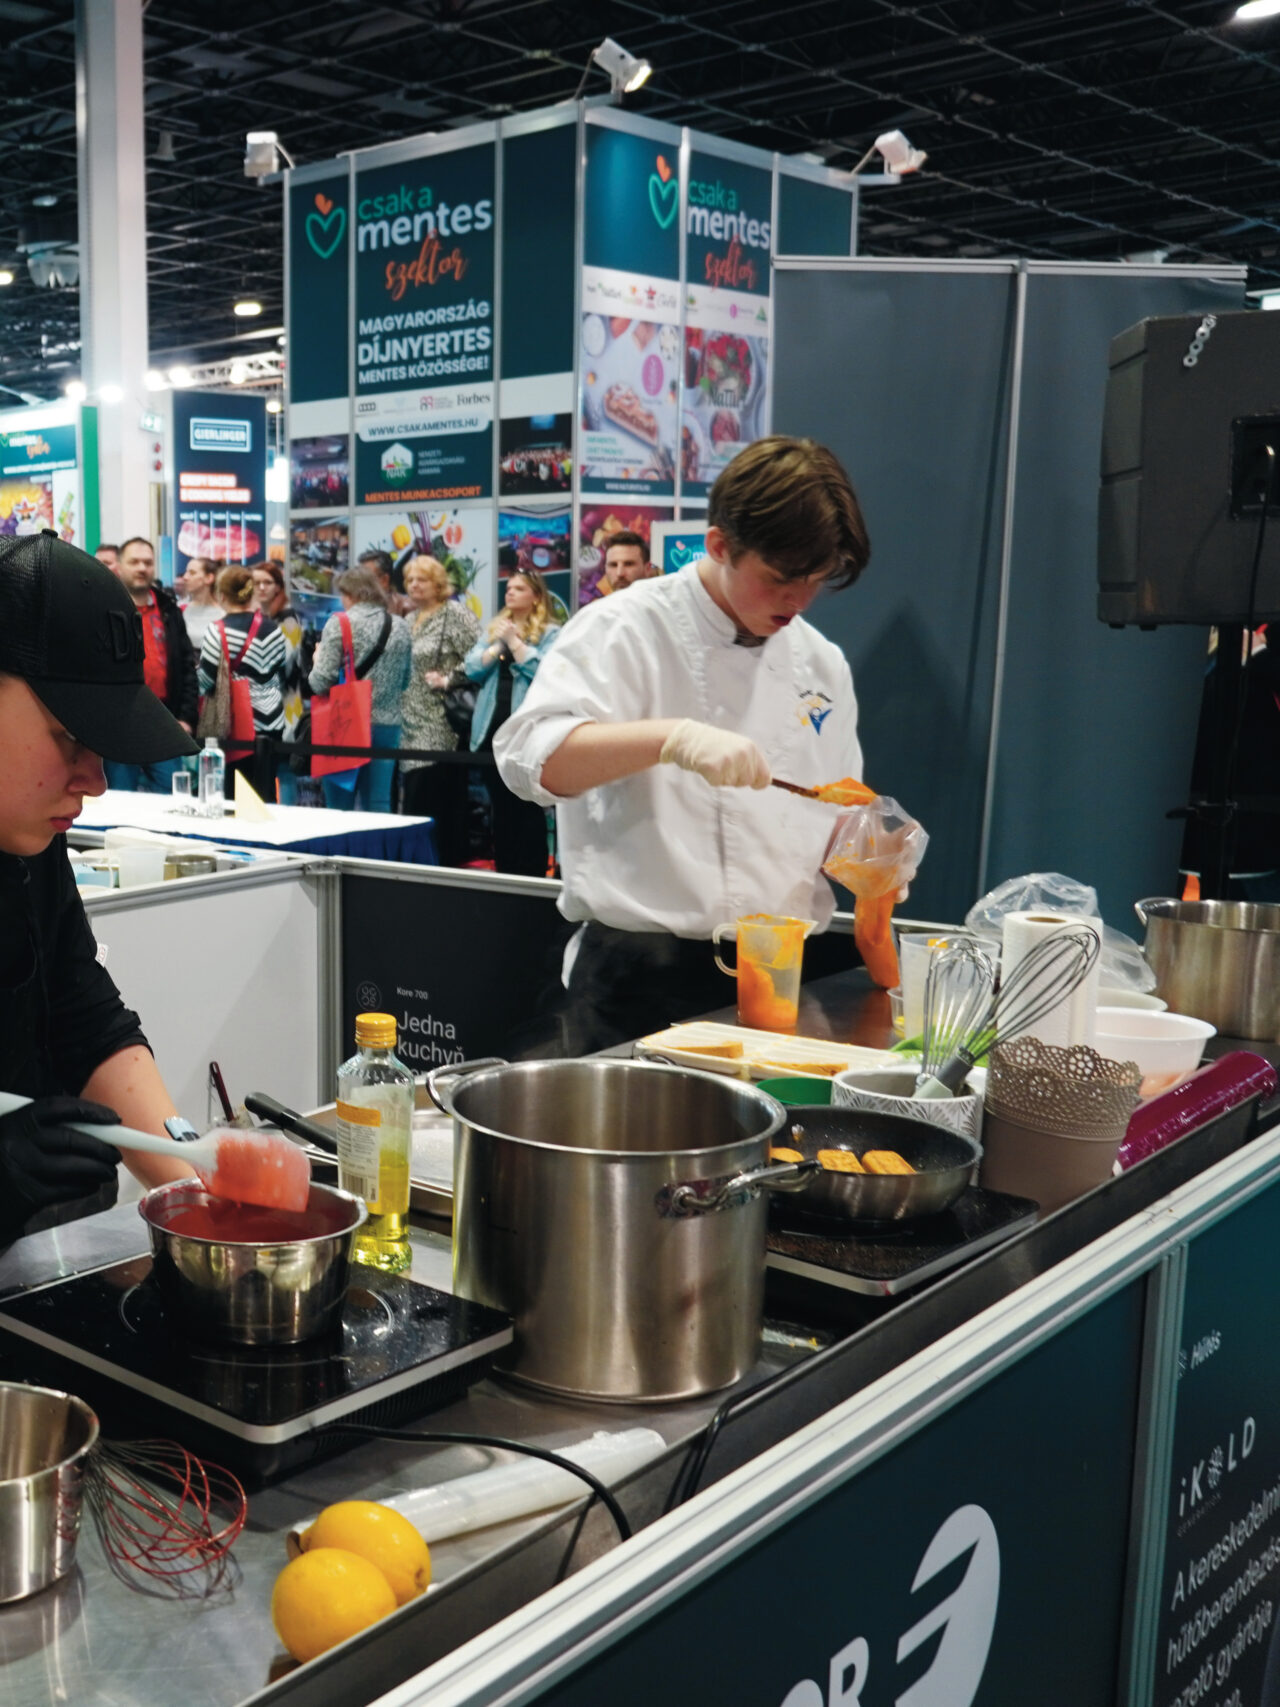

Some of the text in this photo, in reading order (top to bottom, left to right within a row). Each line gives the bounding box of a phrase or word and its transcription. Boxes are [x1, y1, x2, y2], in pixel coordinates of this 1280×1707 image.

[358, 185, 432, 220] csak a
[688, 179, 725, 207] csak
[358, 200, 492, 252] mentes
[688, 206, 770, 249] mentes
[359, 298, 490, 336] MAGYARORSZÁG
[358, 326, 491, 366] DÍJNYERTES
[358, 355, 489, 385] MENTES KÖZÖSSÉGE!
[457, 392, 491, 411] Forbes
[368, 418, 479, 437] WWW.CSAKAMENTES.HU
[365, 486, 482, 503] MENTES MUNKACSOPORT
[415, 989, 429, 1000] 700
[398, 1010, 456, 1040] Jedna
[1171, 1571, 1186, 1612] A
